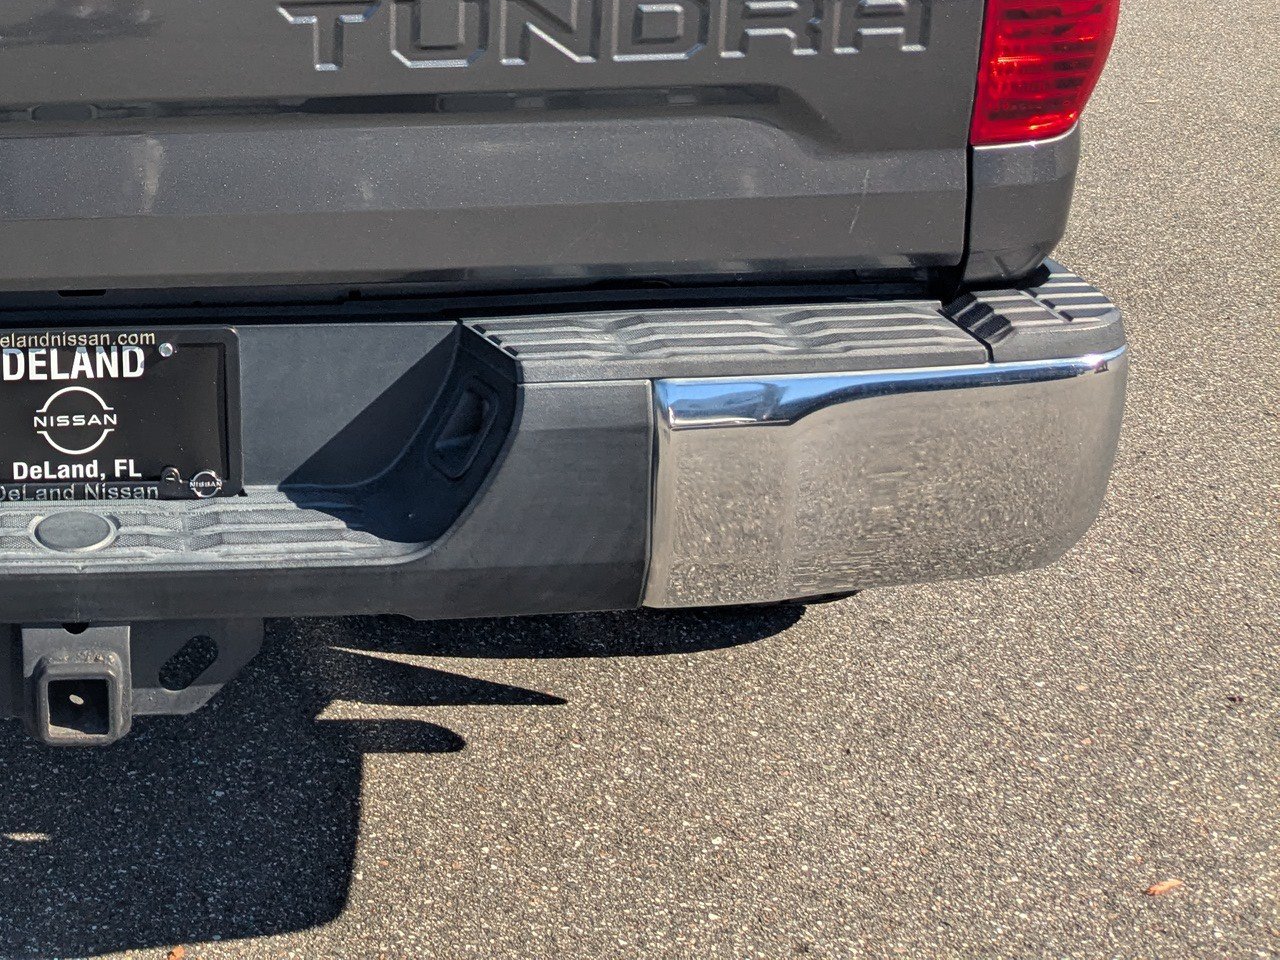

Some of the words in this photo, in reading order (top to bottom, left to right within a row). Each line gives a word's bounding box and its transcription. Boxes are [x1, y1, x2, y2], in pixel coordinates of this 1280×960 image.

[2, 346, 145, 381] DELAND
[33, 413, 117, 427] NISSAN
[12, 460, 106, 480] DeLand,
[113, 458, 142, 478] FL
[85, 483, 159, 500] Nissan
